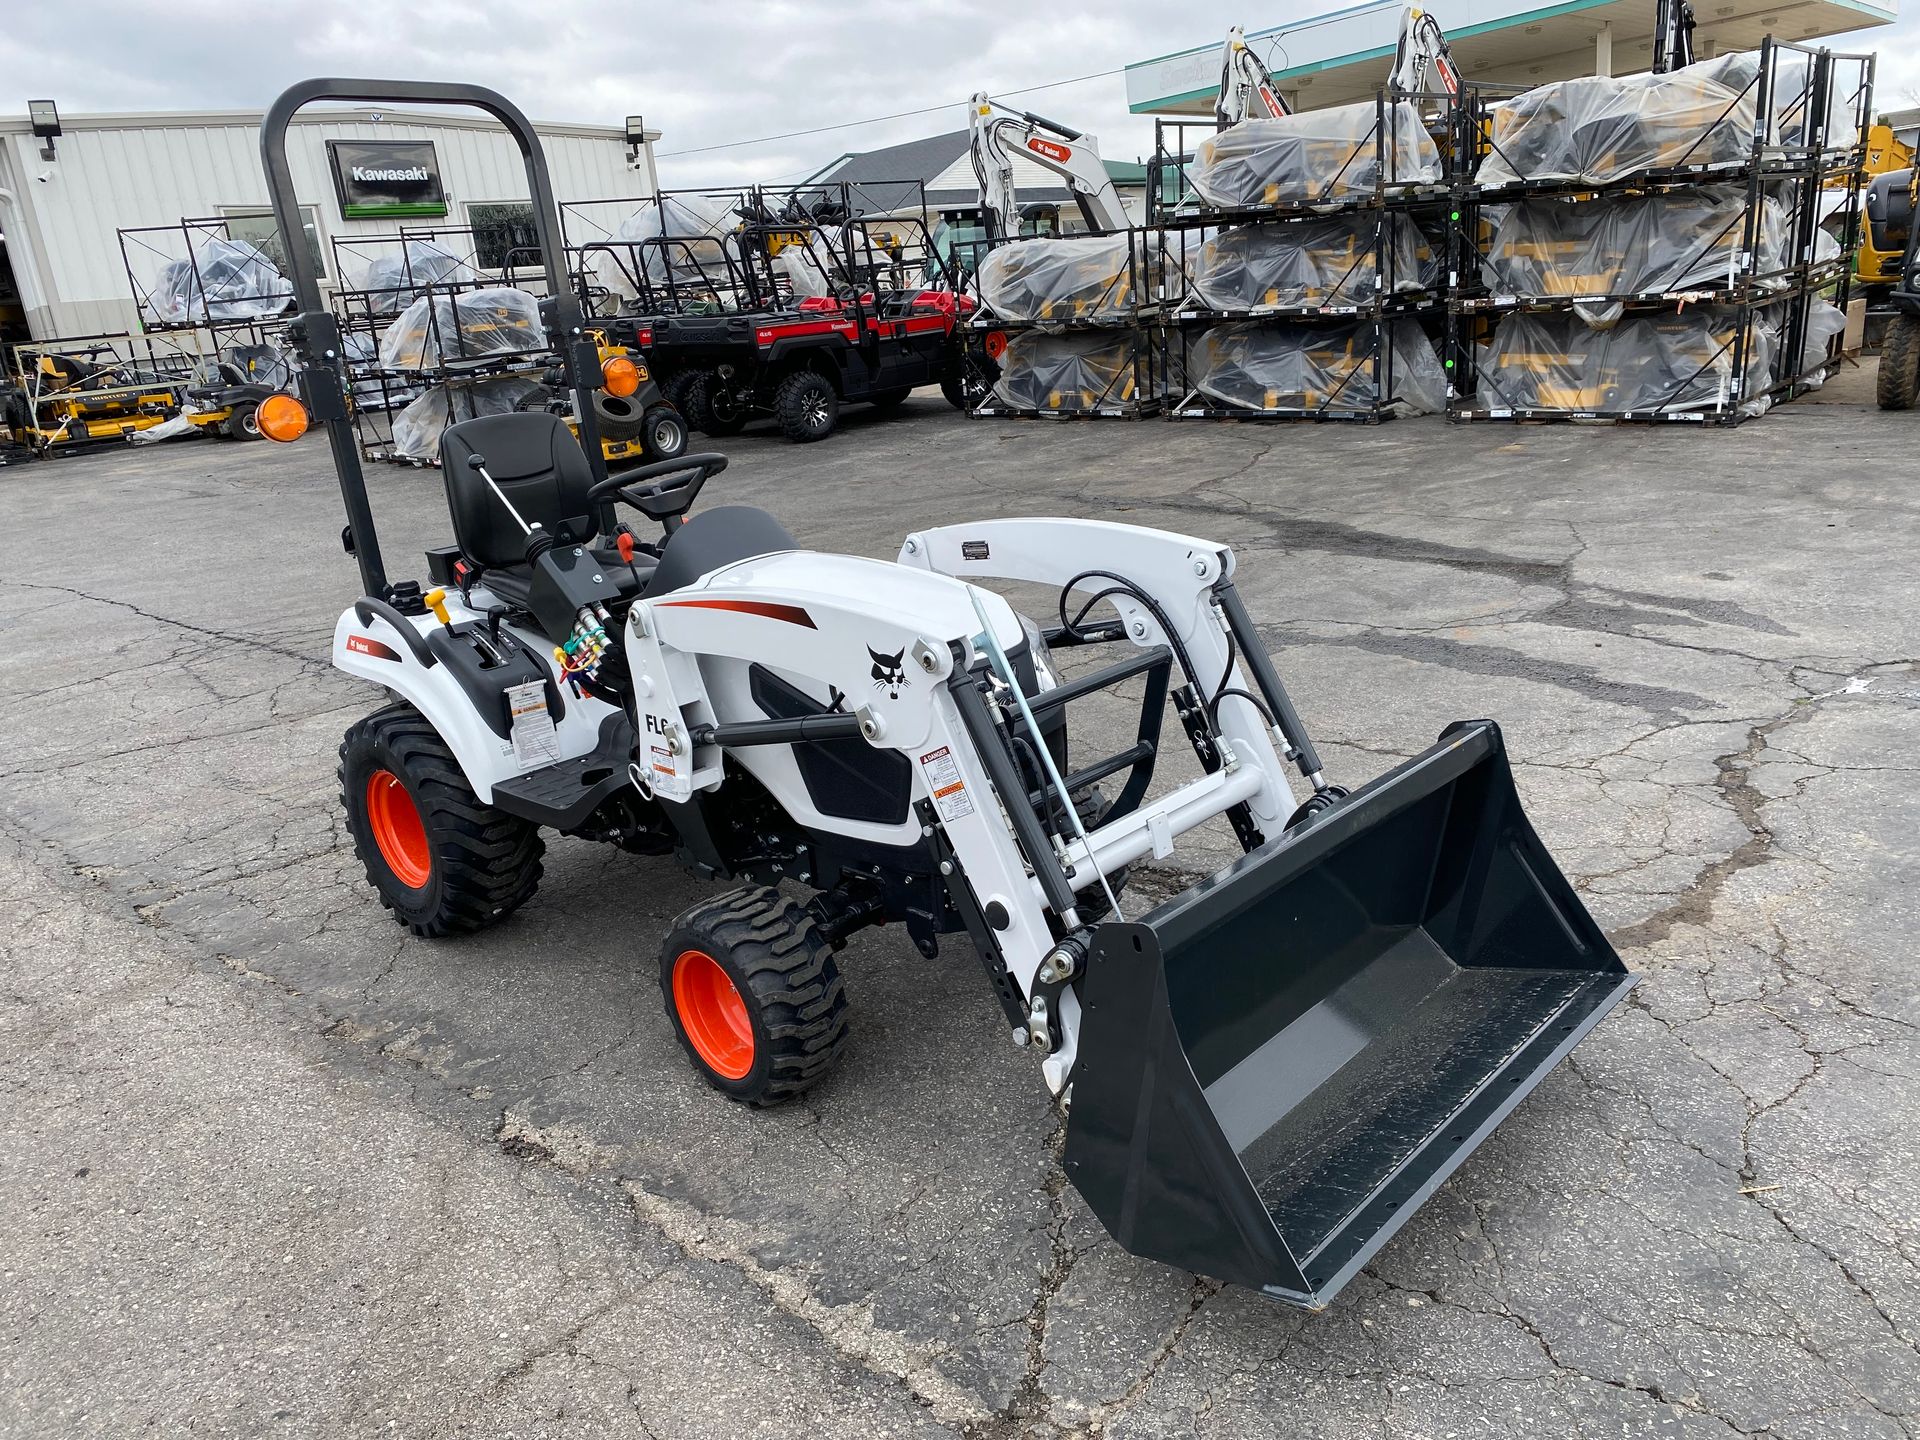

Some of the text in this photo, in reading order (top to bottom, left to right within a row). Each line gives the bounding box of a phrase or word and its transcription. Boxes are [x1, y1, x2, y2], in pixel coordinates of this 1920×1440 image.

[1044, 145, 1060, 158] Bobcat
[352, 167, 429, 181] Kawasaki
[831, 322, 854, 330] Kawasaki
[91, 393, 128, 401] HUSTLER
[356, 641, 369, 652] Bobcat
[927, 748, 948, 761] DANGER
